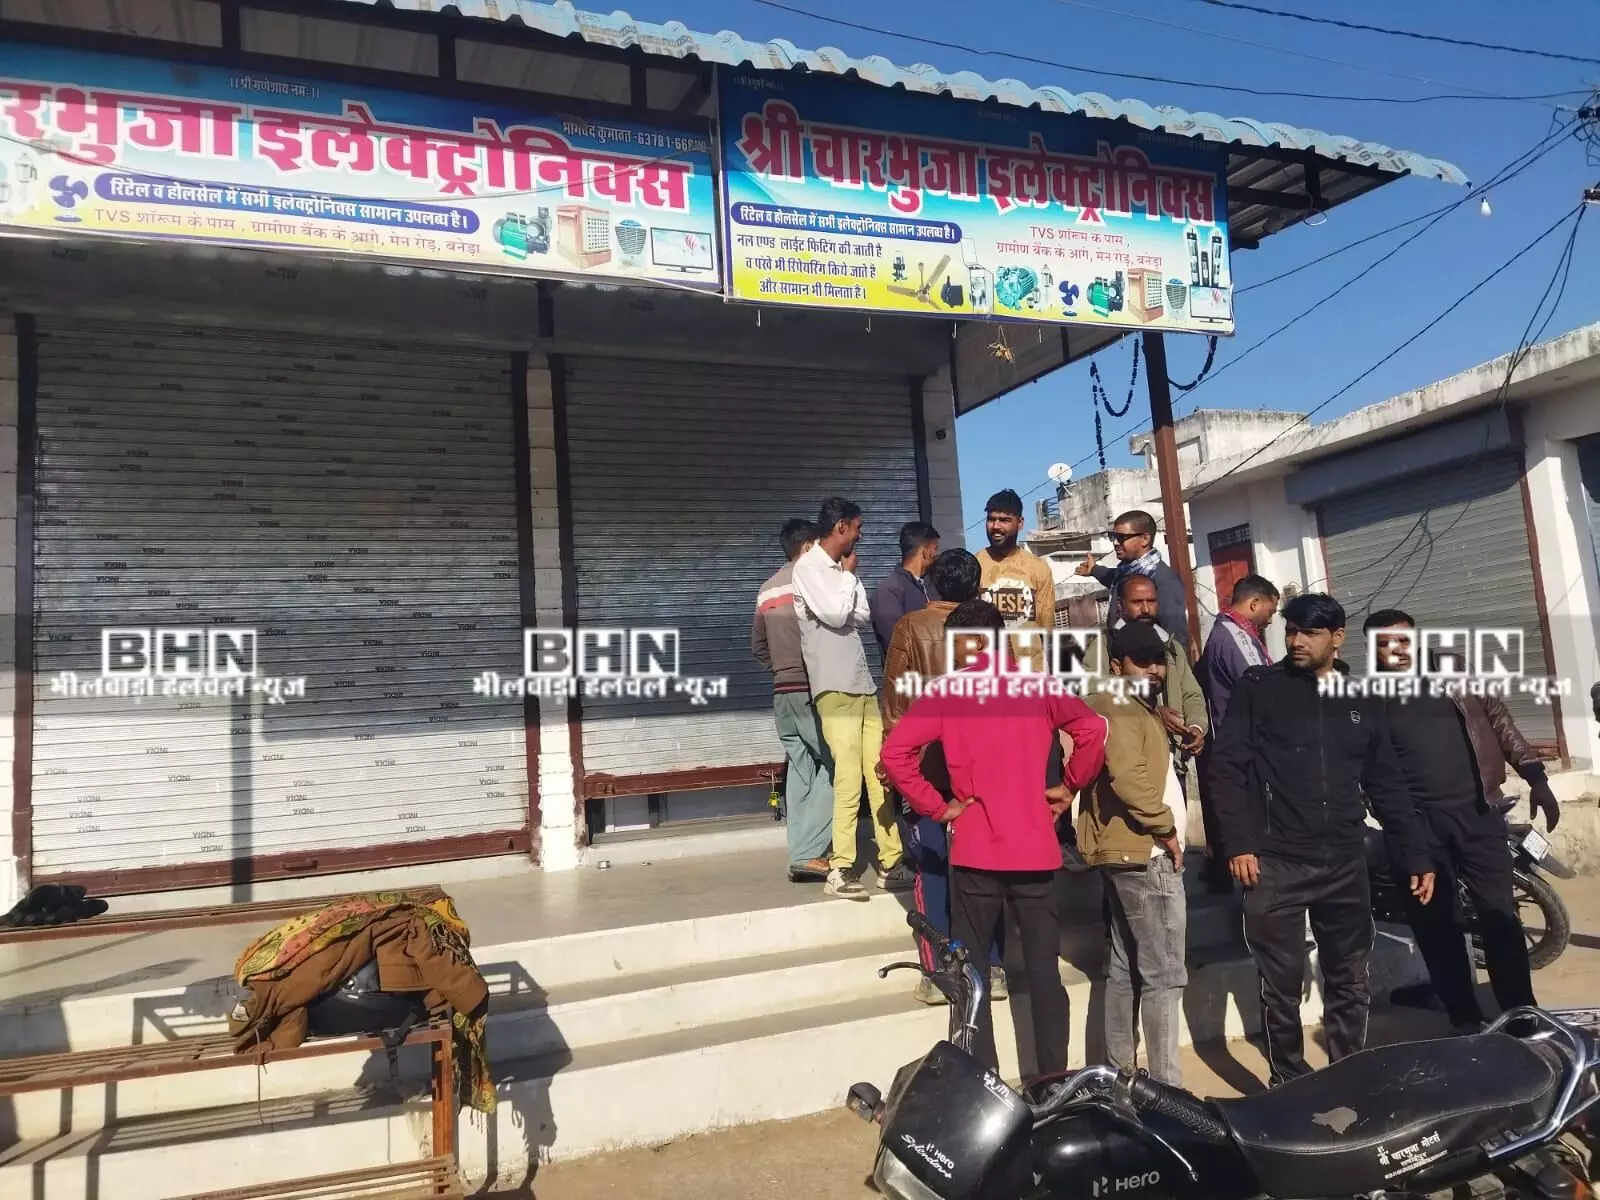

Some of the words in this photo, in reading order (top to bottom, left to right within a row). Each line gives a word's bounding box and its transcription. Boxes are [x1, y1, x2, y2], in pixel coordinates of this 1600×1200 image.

[251, 98, 693, 213] इलेक्ट्रोनिक्स
[735, 99, 806, 184] श्री
[806, 121, 981, 216] चारभुजा
[984, 131, 1217, 228] इलेक्ट्रोनिक्स
[110, 176, 150, 198] रिटेल
[152, 184, 163, 198] व
[167, 182, 223, 204] होलसेल
[225, 184, 240, 205] में
[240, 189, 269, 208] सभी
[359, 204, 402, 222] सामान
[95, 208, 131, 223] TVS
[185, 212, 203, 227] के
[206, 216, 236, 230] पास
[250, 219, 296, 236] ग्रामीण
[331, 226, 347, 241] के
[388, 231, 411, 247] मेन
[740, 204, 763, 221] रिटेल
[765, 211, 772, 221] व
[774, 208, 807, 226] होलसेल
[818, 215, 836, 229] सभी
[889, 222, 914, 236] सामान
[737, 234, 754, 247] नल
[838, 240, 851, 256] की
[853, 242, 874, 257] जाती
[1030, 225, 1055, 239] TVS
[1103, 234, 1122, 245] पास
[775, 258, 785, 271] भी
[849, 263, 868, 278] जाते
[760, 277, 777, 293] और
[780, 280, 809, 296] सामान
[811, 282, 821, 296] भी
[823, 282, 853, 299] मिलता
[934, 1148, 955, 1170] Hero
[1115, 1169, 1161, 1192] Hero
